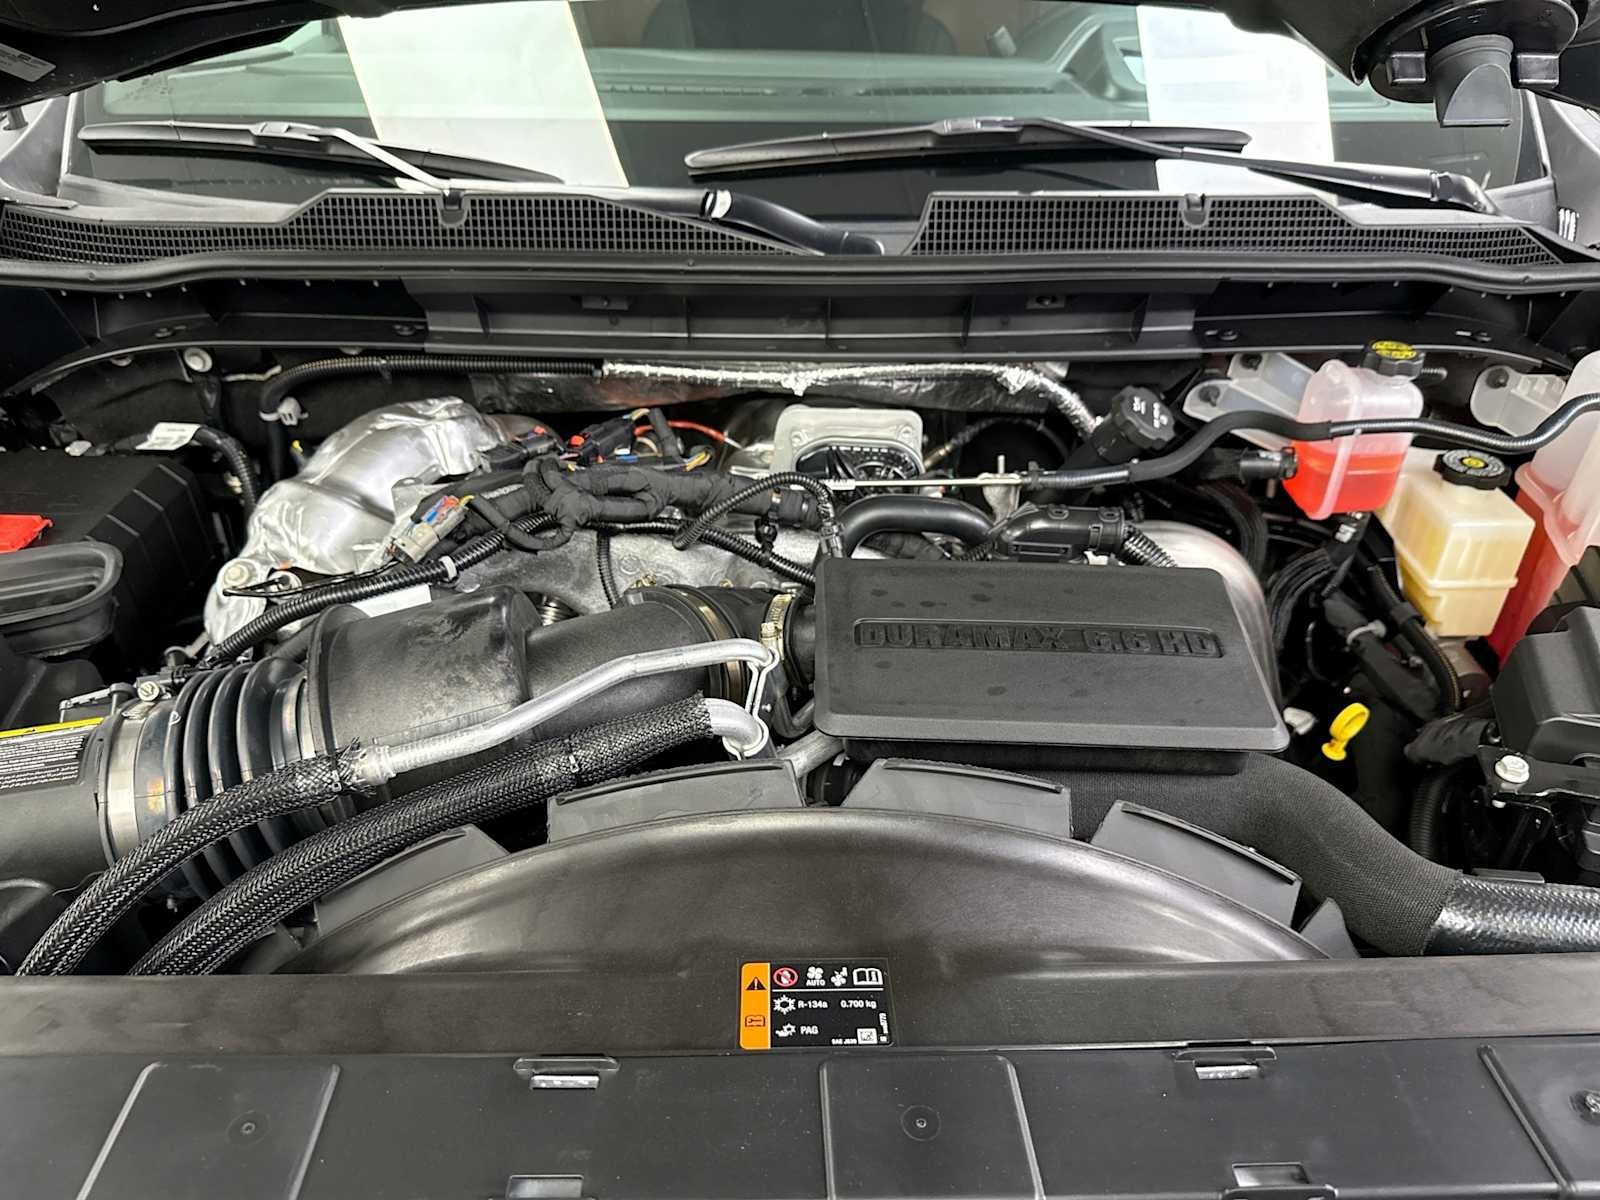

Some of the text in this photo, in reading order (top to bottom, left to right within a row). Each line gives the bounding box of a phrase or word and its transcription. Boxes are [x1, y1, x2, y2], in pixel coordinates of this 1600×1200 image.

[859, 623, 1218, 656] DURAMAX 6.6 HD
[797, 1000, 878, 1010] R-134a 0.700 kg
[800, 1025, 819, 1035] PAG
